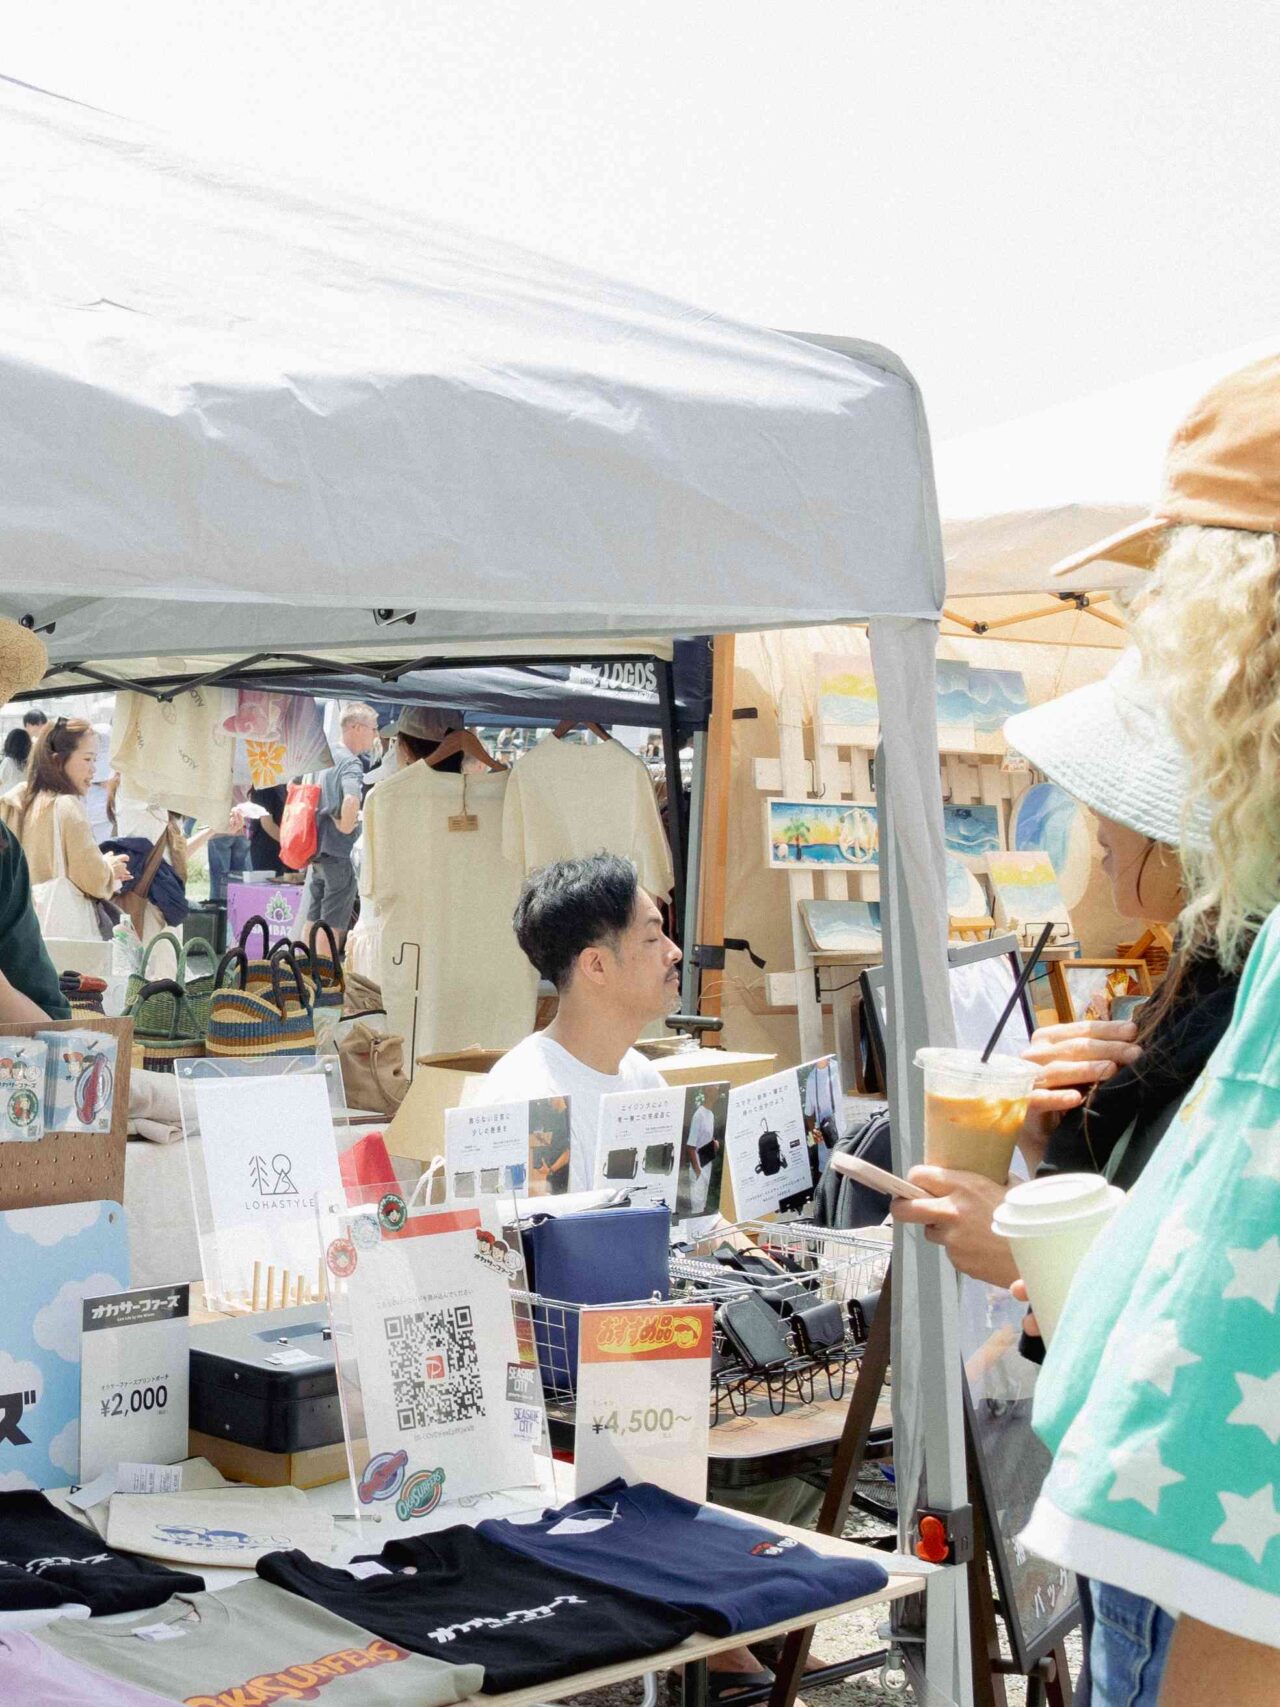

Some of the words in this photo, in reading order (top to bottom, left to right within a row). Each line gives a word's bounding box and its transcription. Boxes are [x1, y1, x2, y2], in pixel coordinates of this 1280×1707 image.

[245, 1198, 316, 1211] LOHASTYLE
[91, 1294, 181, 1320] オカサーファーズ
[596, 1314, 674, 1346] おすすめ品
[100, 1385, 168, 1418] ¥2,000
[185, 1640, 400, 1707] KASURFERS
